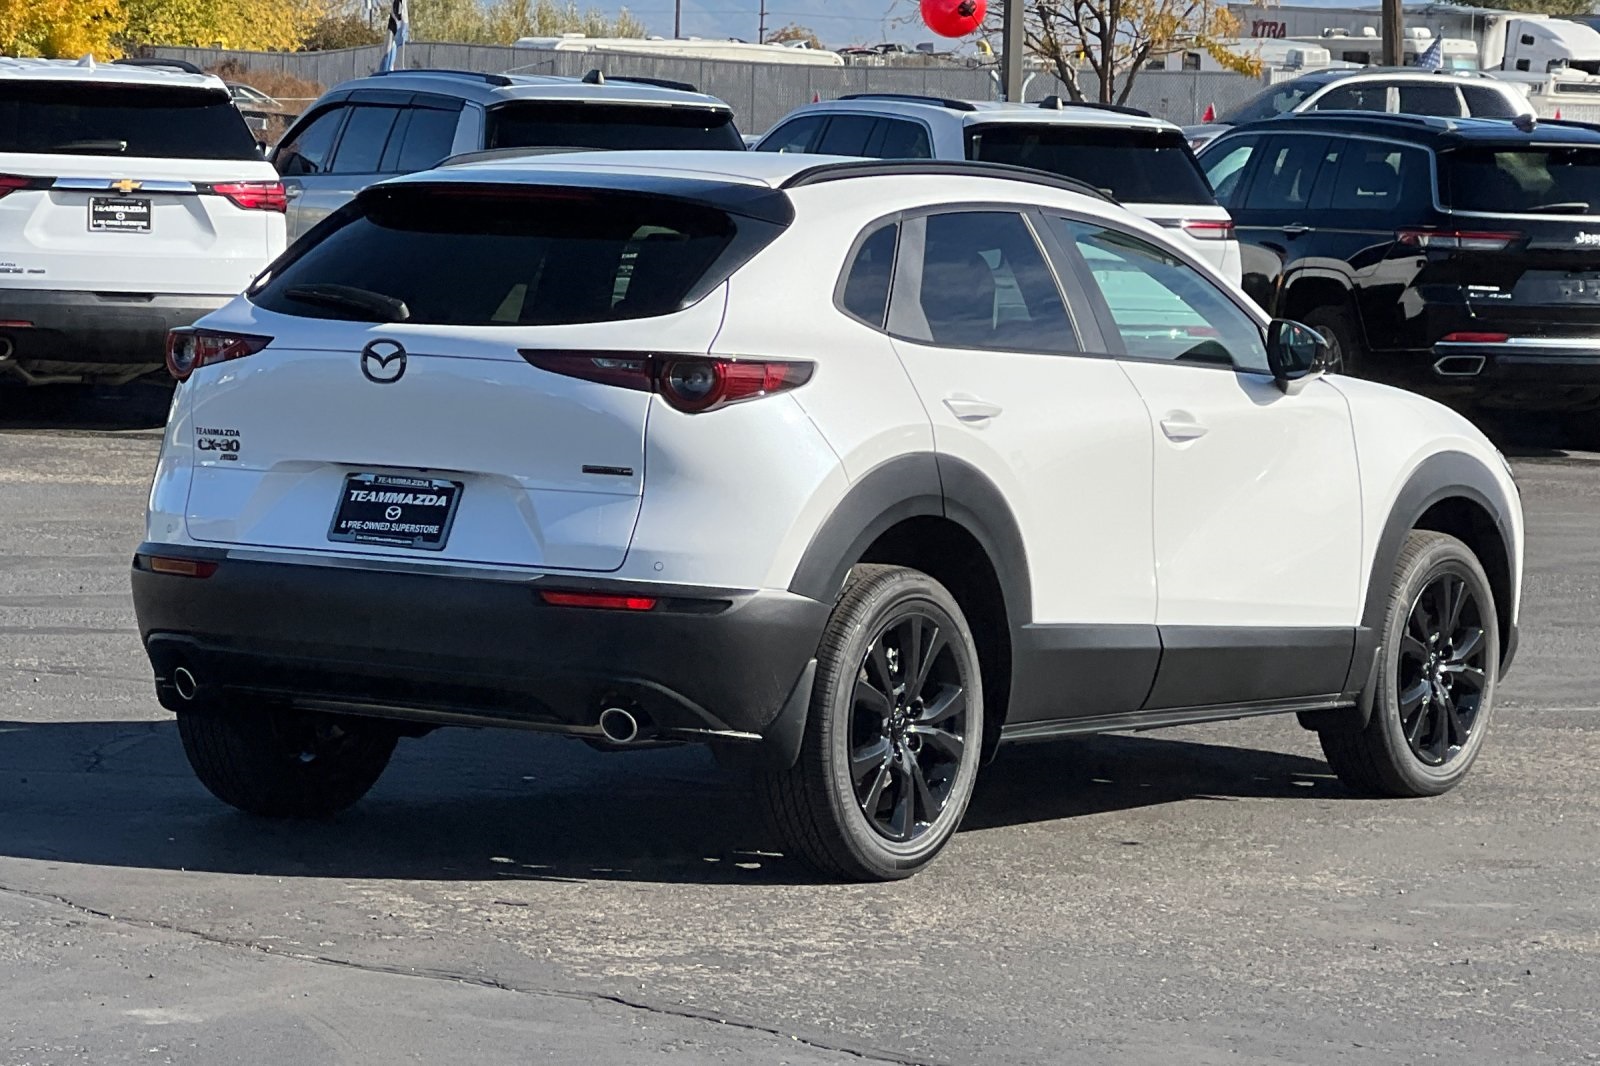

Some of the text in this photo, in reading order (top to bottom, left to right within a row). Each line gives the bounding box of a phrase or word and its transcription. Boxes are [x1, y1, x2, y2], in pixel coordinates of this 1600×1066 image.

[1251, 20, 1286, 38] XTRA
[1574, 231, 1600, 246] Jee
[195, 427, 241, 437] TEAMMAZDA
[197, 438, 241, 452] CX-30
[377, 477, 429, 488] TEAMMAZDA
[350, 490, 447, 506] TEAMMAZDA
[341, 520, 440, 534] & PRE-OWNED SUPERSTORE
